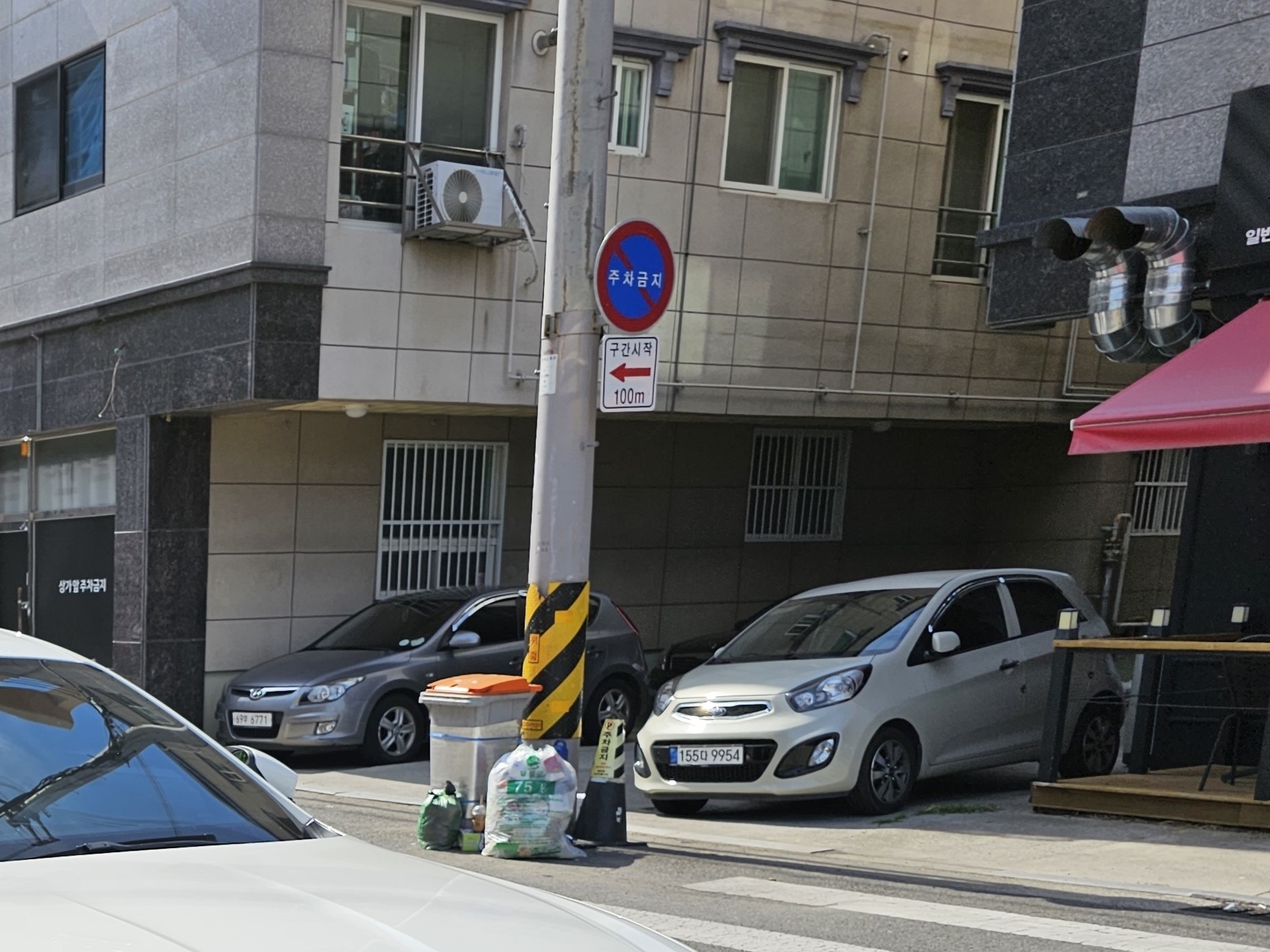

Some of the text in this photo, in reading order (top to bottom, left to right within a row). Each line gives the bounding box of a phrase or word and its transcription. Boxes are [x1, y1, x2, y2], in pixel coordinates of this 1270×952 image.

[607, 269, 663, 289] 주차금지
[609, 342, 653, 357] 구간시작
[614, 388, 645, 405] 100m
[250, 714, 268, 725] 6771
[599, 731, 612, 761] 주차금지
[711, 748, 740, 762] 9954
[514, 780, 533, 794] 75
